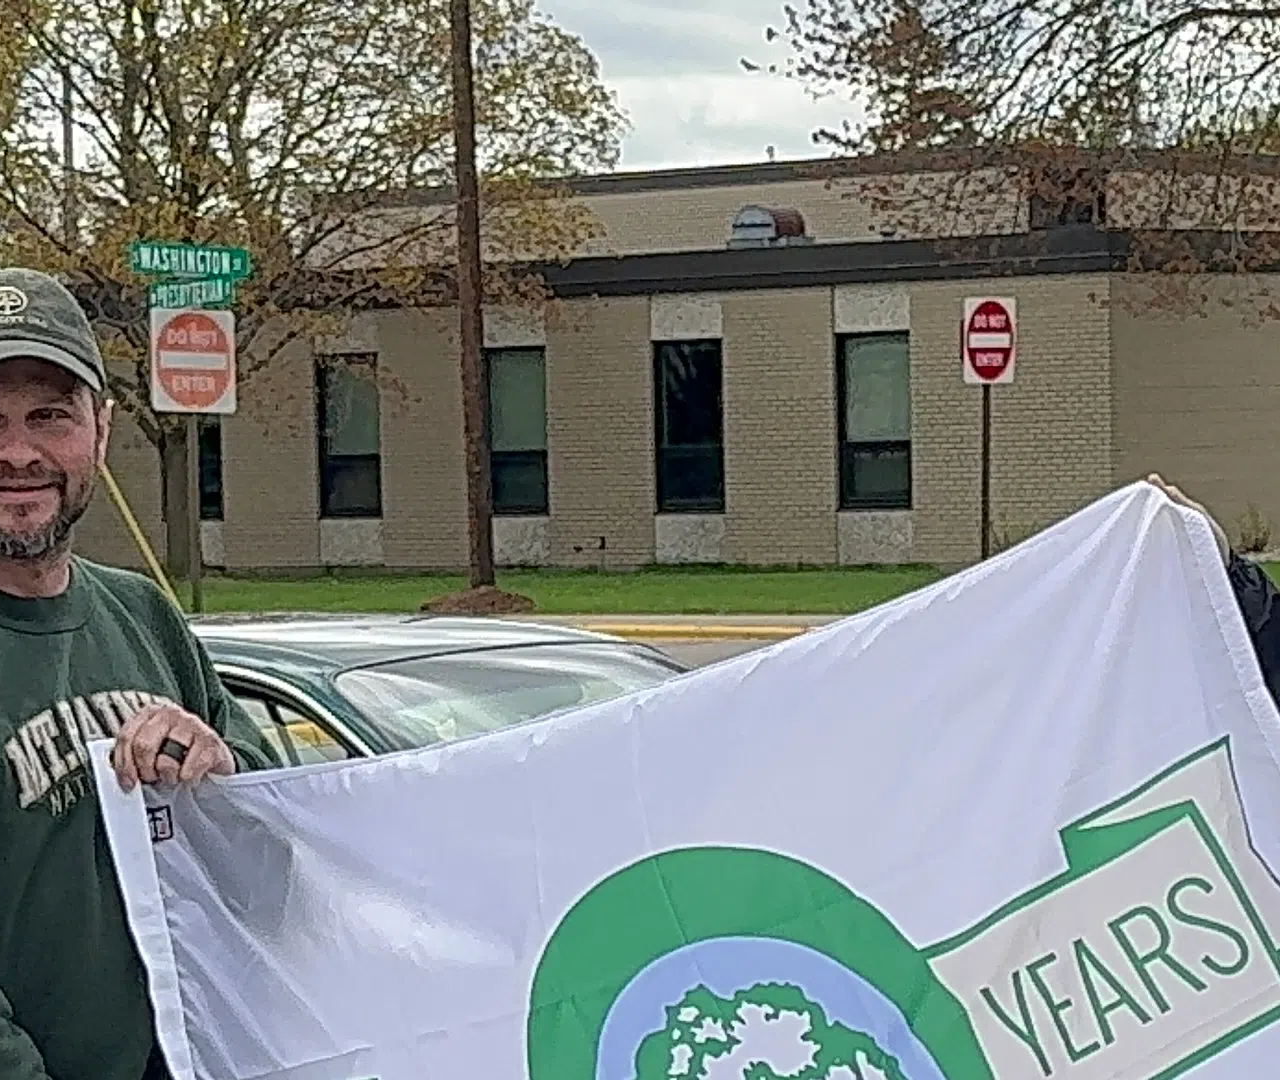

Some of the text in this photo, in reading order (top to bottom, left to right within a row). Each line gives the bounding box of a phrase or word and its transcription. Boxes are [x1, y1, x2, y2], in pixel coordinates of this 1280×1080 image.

[138, 246, 231, 275] WASHINGTON
[974, 313, 1007, 328] DO NOT
[167, 328, 218, 346] DO NOT
[975, 352, 1004, 367] ENTER
[172, 375, 216, 393] ENTER
[978, 876, 1250, 1078] YEARS
